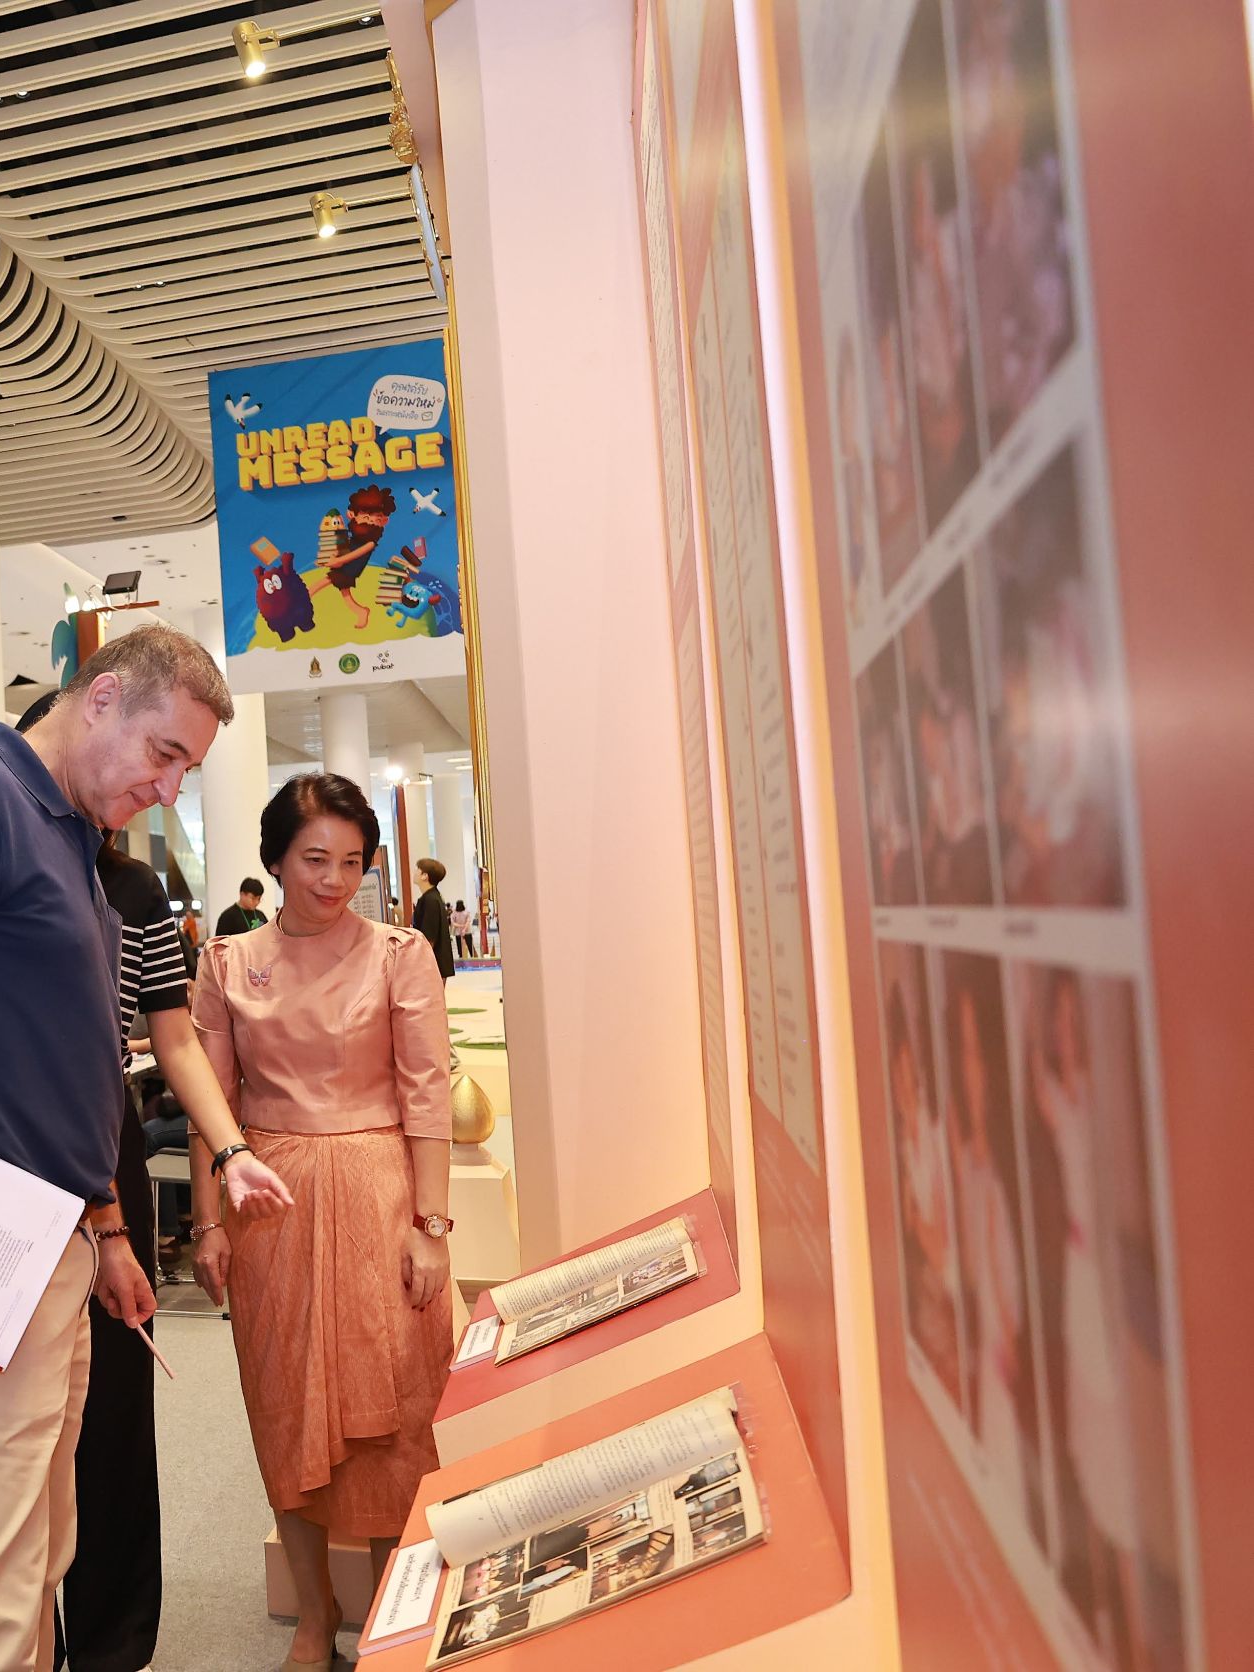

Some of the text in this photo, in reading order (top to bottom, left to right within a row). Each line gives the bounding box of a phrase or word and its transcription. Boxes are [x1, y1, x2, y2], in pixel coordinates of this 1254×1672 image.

[376, 390, 436, 409] ข้อความใหม่
[236, 416, 376, 458] UNREAD
[238, 432, 445, 491] MESSAGE
